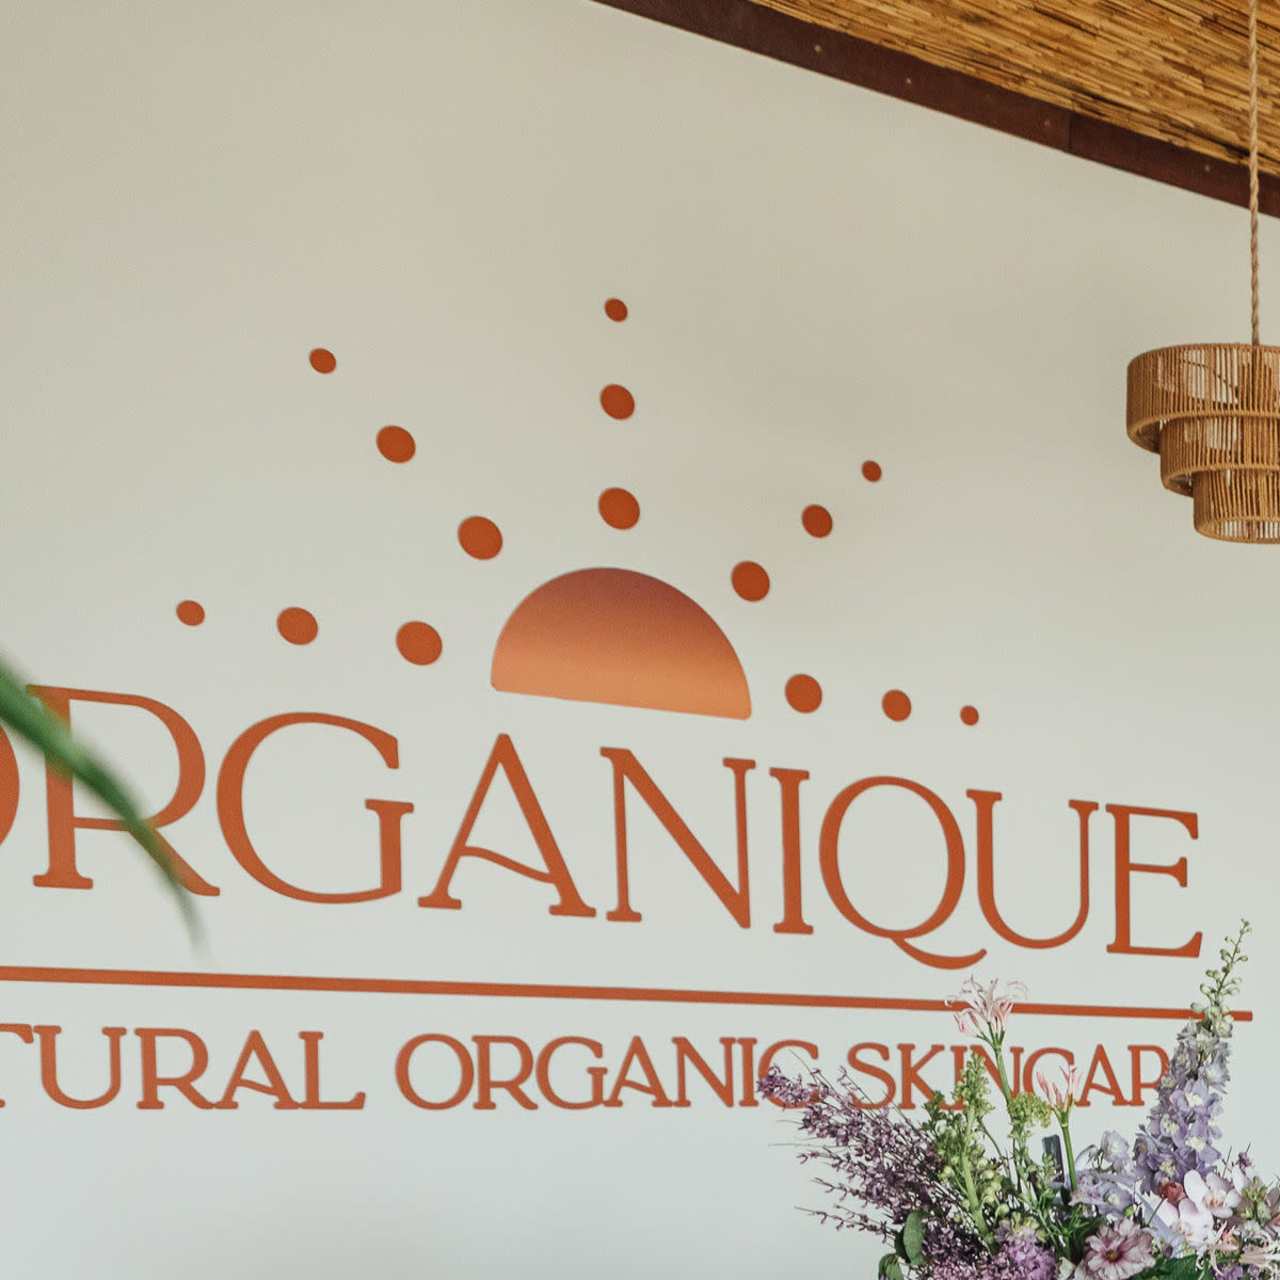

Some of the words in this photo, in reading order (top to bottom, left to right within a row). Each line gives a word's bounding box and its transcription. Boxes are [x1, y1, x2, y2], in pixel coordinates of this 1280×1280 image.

[0, 684, 1203, 969] RGANIQUE
[395, 1034, 819, 1111] ORGANIC
[846, 1041, 1170, 1111] SKINCAR
